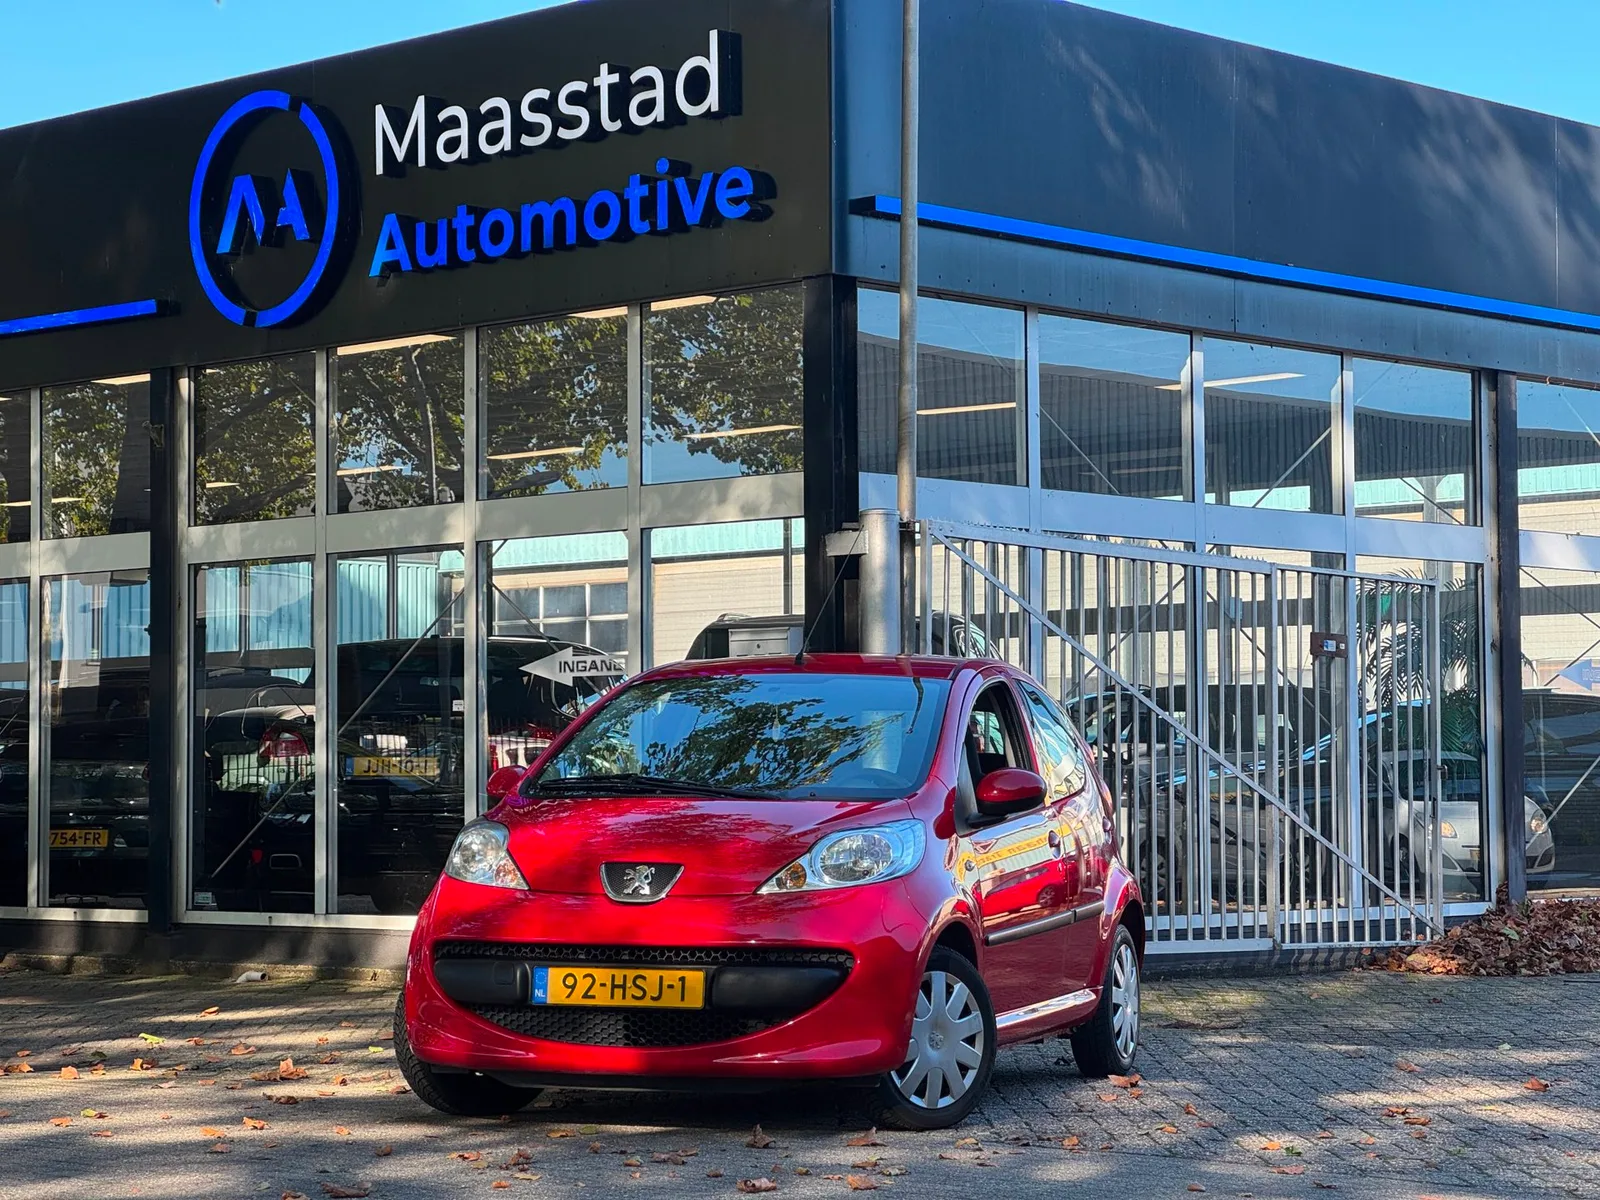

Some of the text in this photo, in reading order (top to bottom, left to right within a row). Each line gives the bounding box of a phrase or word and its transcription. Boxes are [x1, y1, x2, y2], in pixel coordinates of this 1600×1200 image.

[375, 29, 719, 175] Maasstad
[369, 157, 753, 277] Automotive
[534, 972, 686, 1001] NL 92-HSJ-1
